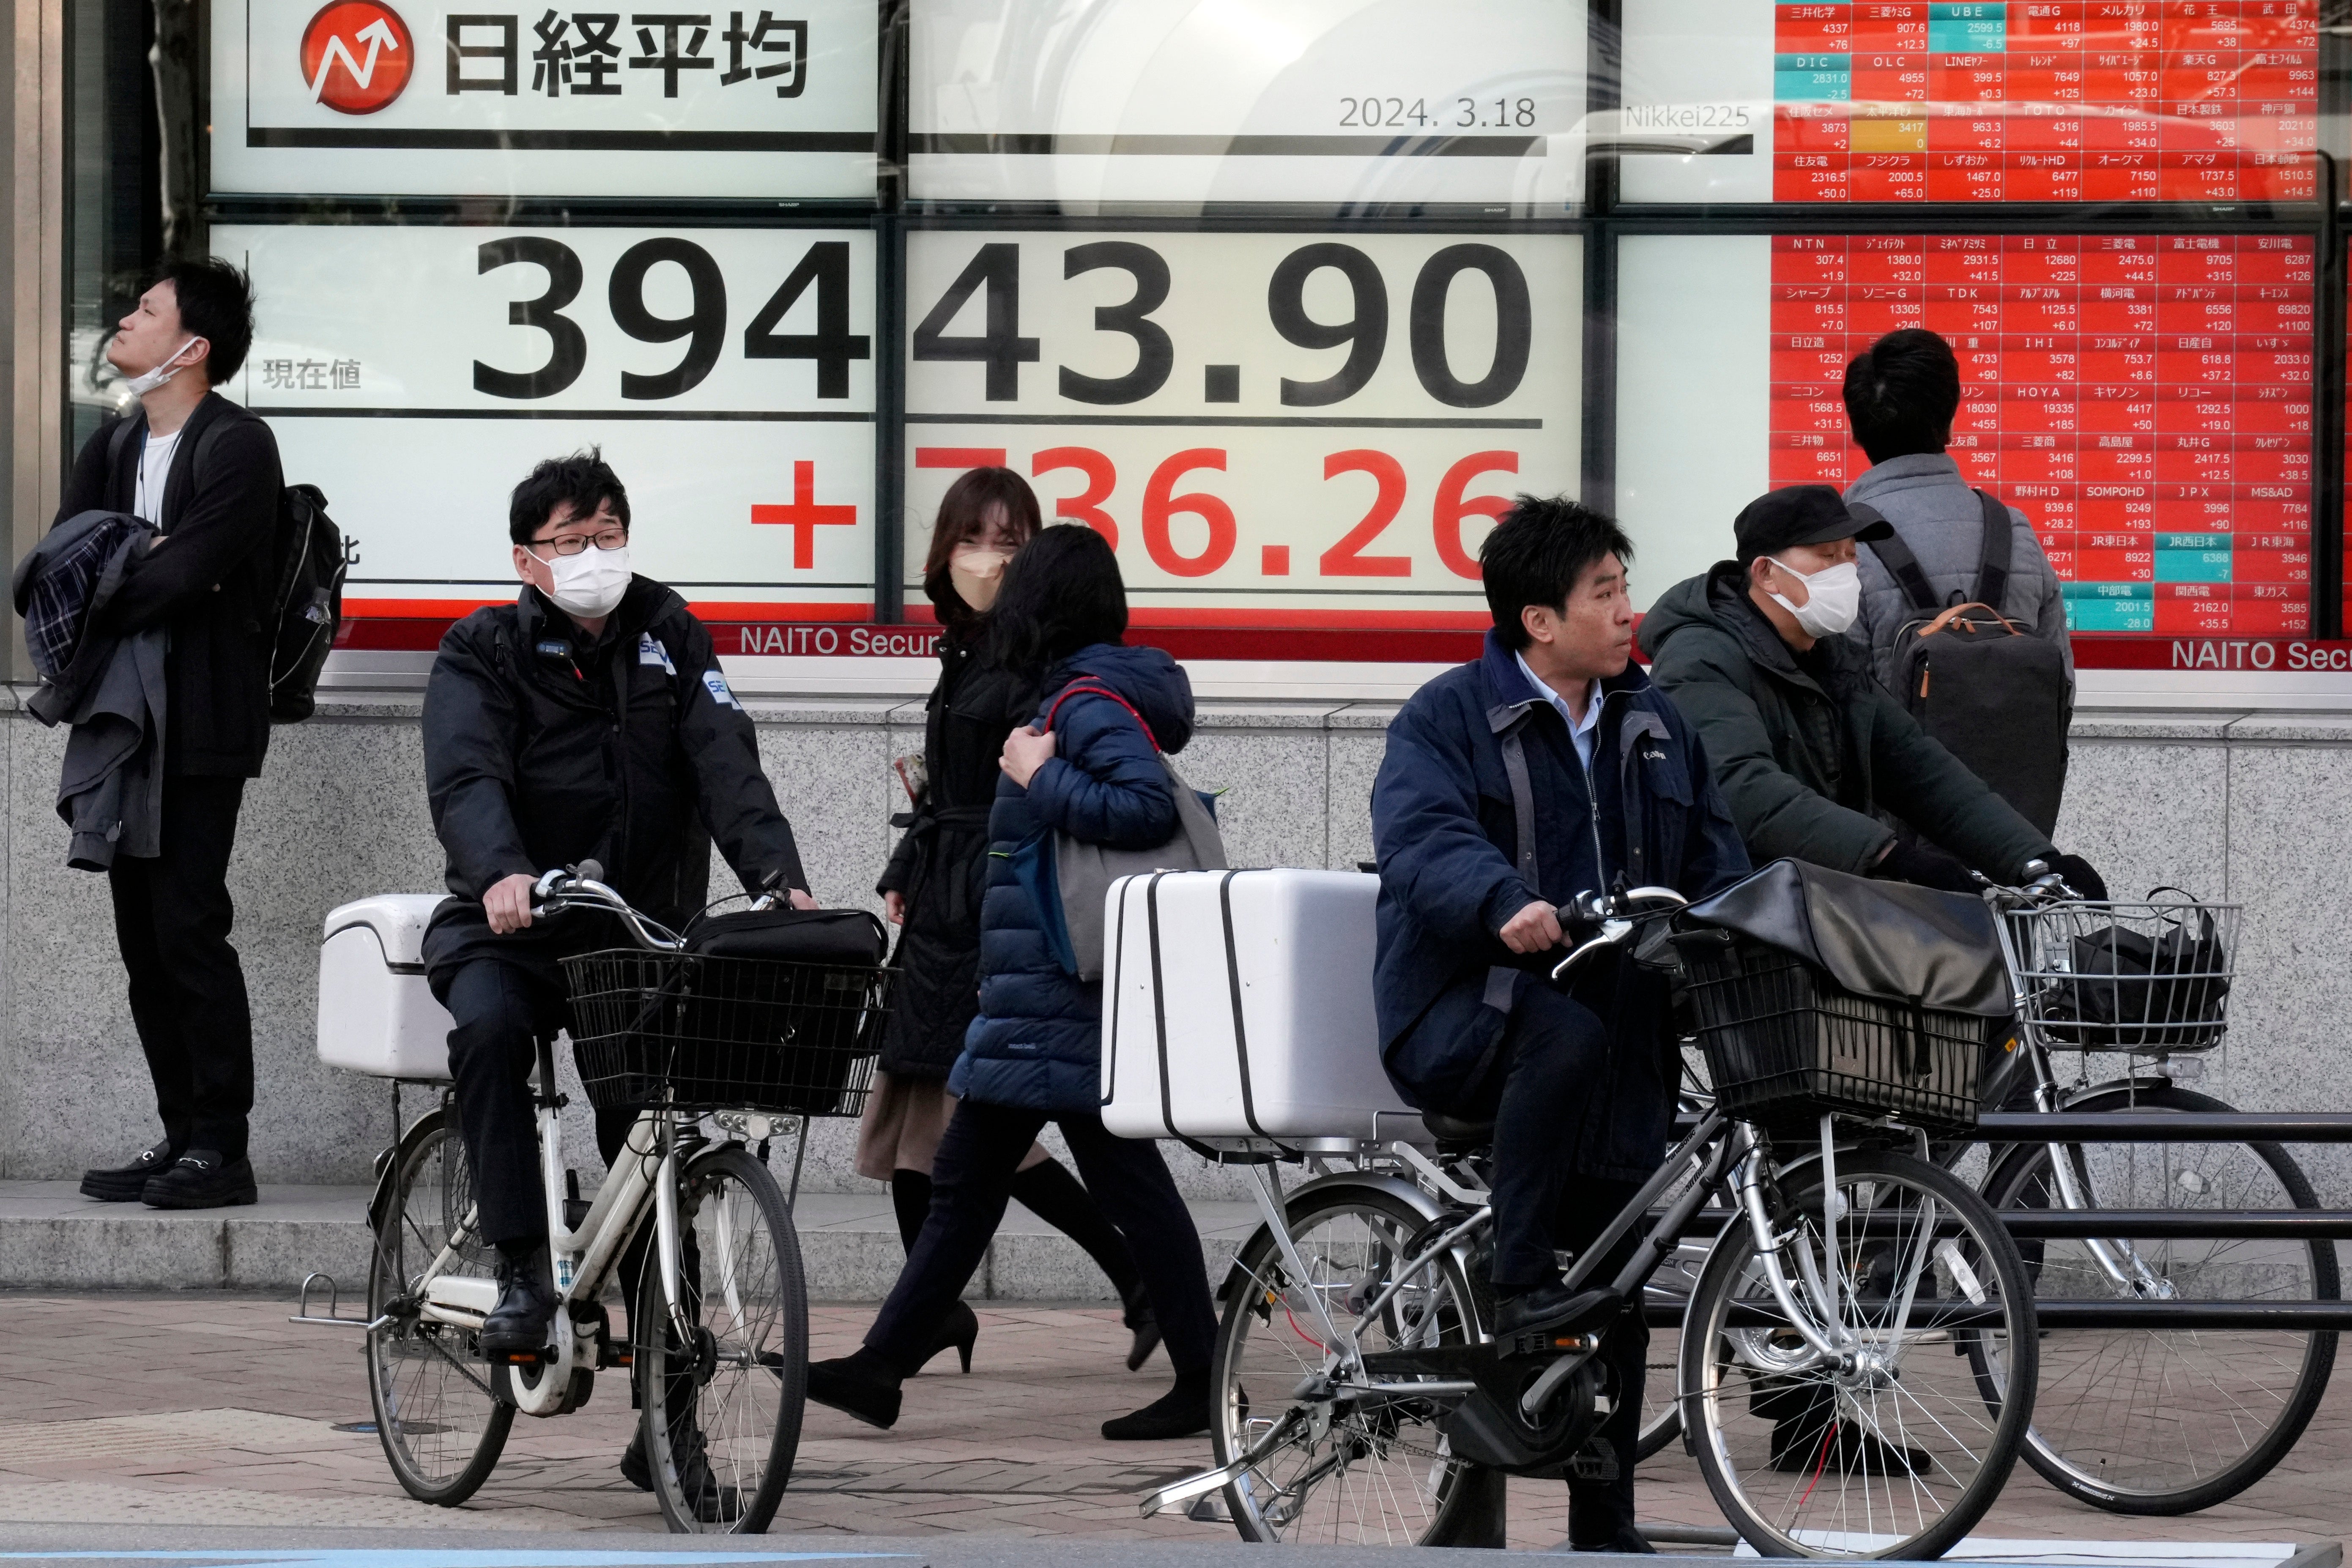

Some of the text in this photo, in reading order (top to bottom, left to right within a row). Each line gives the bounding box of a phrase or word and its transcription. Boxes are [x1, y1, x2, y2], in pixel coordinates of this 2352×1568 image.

[1791, 6, 1835, 18] 三井化学
[2028, 5, 2061, 16] 電通G
[2100, 4, 2145, 16] メルカリ
[1822, 23, 1848, 33] 4337
[1897, 23, 1925, 33] 907.6
[1967, 23, 2003, 33] 2599.5
[2054, 22, 2080, 32] 4118
[2124, 21, 2159, 32] 1980.0
[2211, 20, 2238, 31] 5695
[2289, 20, 2316, 31] 4374
[1896, 39, 1925, 49] +12.3
[446, 8, 808, 98] 日経平均
[2183, 54, 2216, 66] 楽天G
[1813, 73, 1847, 84] 2831.0
[1899, 73, 1925, 83] 4955
[1973, 72, 2002, 82] 399.5
[2054, 72, 2080, 82] 7649
[2123, 71, 2158, 82] 1057.0
[2207, 71, 2236, 82] 827.3
[2289, 70, 2315, 81] 9963
[2054, 88, 2079, 98] +125
[1339, 97, 1536, 128] 2024. 3.18
[2177, 104, 2222, 115] 日本製鉄
[1626, 105, 1750, 127] Nikkei225
[1821, 122, 1847, 133] 3873
[1899, 122, 1924, 132] 3417
[1972, 122, 2002, 132] 963.3
[2053, 122, 2079, 132] 4316
[2122, 121, 2157, 132] 1985.5
[2209, 120, 2235, 131] 3603
[2278, 120, 2314, 130] 2021.0
[1794, 156, 1828, 167] 住友電
[1867, 156, 1910, 167] フジクラ
[1944, 154, 1988, 166] しずおか
[2098, 154, 2144, 165] オークマ
[2182, 153, 2216, 165] アマダ
[1811, 172, 1846, 182] 2316.5
[1888, 172, 1923, 182] 2000.5
[1966, 172, 2001, 182] 1467.0
[2052, 171, 2078, 181] 6477
[2130, 170, 2156, 181] 7150
[2200, 170, 2234, 181] 1737.5
[2278, 170, 2313, 181] 1510.5
[1817, 188, 1846, 198] +50.0
[1894, 188, 1923, 198] +65.0
[2052, 187, 2078, 197] +119
[2205, 187, 2234, 197] +43.0
[2101, 238, 2136, 249] 三菱電
[2174, 237, 2219, 249] 富士電機
[2258, 238, 2293, 249] 安川電
[1815, 255, 1844, 265] 307.4
[1887, 255, 1921, 265] 1380.0
[1963, 254, 1999, 265] 2931.5
[2045, 255, 2076, 265] 12680
[2119, 255, 2154, 265] 2475.0
[2206, 254, 2232, 265] 9705
[2285, 254, 2311, 265] 6287
[1892, 271, 1921, 281] +32.0
[2125, 271, 2154, 281] +44.5
[2206, 271, 2232, 281] +315
[1787, 286, 1831, 298] シャープ
[1863, 288, 1906, 298] ソニーG
[2100, 287, 2136, 299] 横河電
[1815, 304, 1843, 314] 815.5
[1889, 304, 1921, 314] 13305
[1972, 304, 1998, 314] 7543
[2041, 304, 2075, 315] 1125.5
[2127, 304, 2152, 315] 3381
[2205, 304, 2232, 315] 6556
[2278, 304, 2311, 315] 69820
[2278, 321, 2310, 331] +1100
[1792, 336, 1824, 348] 日立造
[2179, 337, 2212, 348] 日産自
[2256, 337, 2289, 348] いすゞ
[1818, 353, 1843, 364] 1252
[1971, 353, 1997, 364] 4733
[2049, 354, 2075, 364] 3578
[2124, 354, 2153, 364] 753.7
[2201, 354, 2231, 364] 618.8
[2274, 354, 2310, 364] 2033.0
[263, 358, 361, 390] 現在値
[2201, 370, 2231, 380] +37.2
[1790, 387, 1824, 397] ニコン
[2094, 386, 2139, 398] キヤノン
[2179, 387, 2211, 397] リコー
[1809, 402, 1843, 413] 1568.5
[1966, 403, 1997, 413] 18030
[2043, 403, 2074, 413] 19335
[2126, 404, 2152, 413] 4417
[2196, 404, 2231, 414] 1292.5
[2284, 404, 2309, 414] 1000
[1791, 435, 1824, 446] 三井物
[2021, 435, 2055, 447] 三菱商
[2098, 436, 2134, 449] 高島屋
[2177, 436, 2210, 448] 丸井G
[1816, 452, 1841, 462] 6651
[1971, 452, 1996, 462] 3567
[2048, 453, 2074, 463] 3416
[2117, 453, 2152, 463] 2299.5
[2194, 454, 2230, 463] 2417.5
[2283, 454, 2308, 464] 3030
[2048, 469, 2074, 479] +108
[2087, 487, 2145, 496] SOMPOHD
[2251, 487, 2293, 498] MS&AD
[2044, 502, 2074, 513] 939.6
[2125, 503, 2151, 513] 9249
[2204, 503, 2229, 514] 3996
[2282, 504, 2307, 514] 7784
[2091, 535, 2138, 547] JR東日本
[2169, 536, 2218, 547] JR西日本
[2047, 552, 2072, 562] 6271
[2125, 552, 2151, 562] 8922
[2202, 553, 2229, 563] 6388
[2281, 553, 2307, 563] 3946
[2097, 586, 2132, 597] 中部電
[2176, 586, 2210, 597] 関西電
[2253, 586, 2288, 597] 東ガス
[2115, 602, 2150, 612] 2001.5
[2193, 602, 2229, 613] 2162.0
[2281, 603, 2307, 613] 3585
[2281, 619, 2307, 629] +152
[741, 627, 946, 655] NAITO Secur
[2173, 641, 2352, 669] NAITO Sec
[1666, 1129, 1696, 1164] Panasonic
